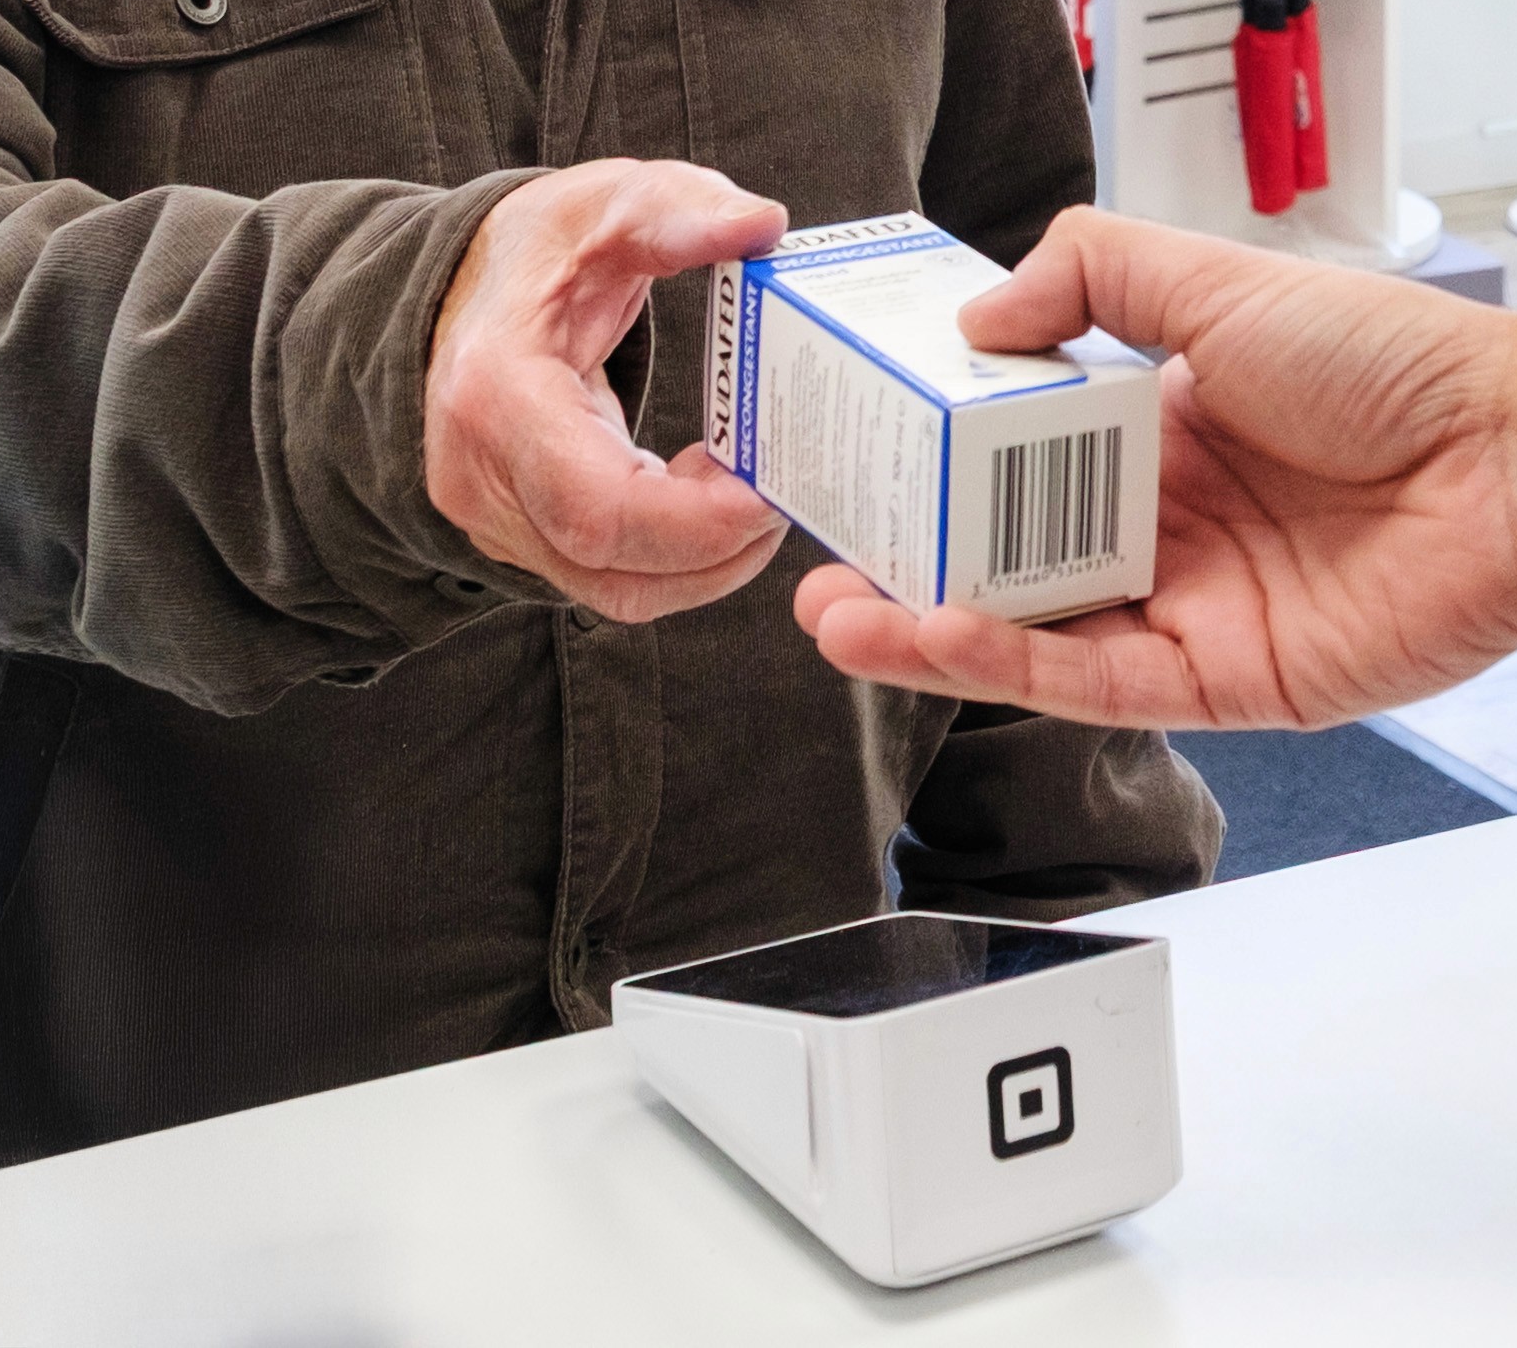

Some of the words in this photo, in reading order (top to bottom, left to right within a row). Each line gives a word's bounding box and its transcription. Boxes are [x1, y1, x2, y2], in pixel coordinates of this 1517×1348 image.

[771, 235, 944, 270] DECONGESTANT
[778, 219, 912, 251] UDAFED
[712, 274, 734, 454] SUDAFED
[741, 279, 759, 472] DECONGESTANT
